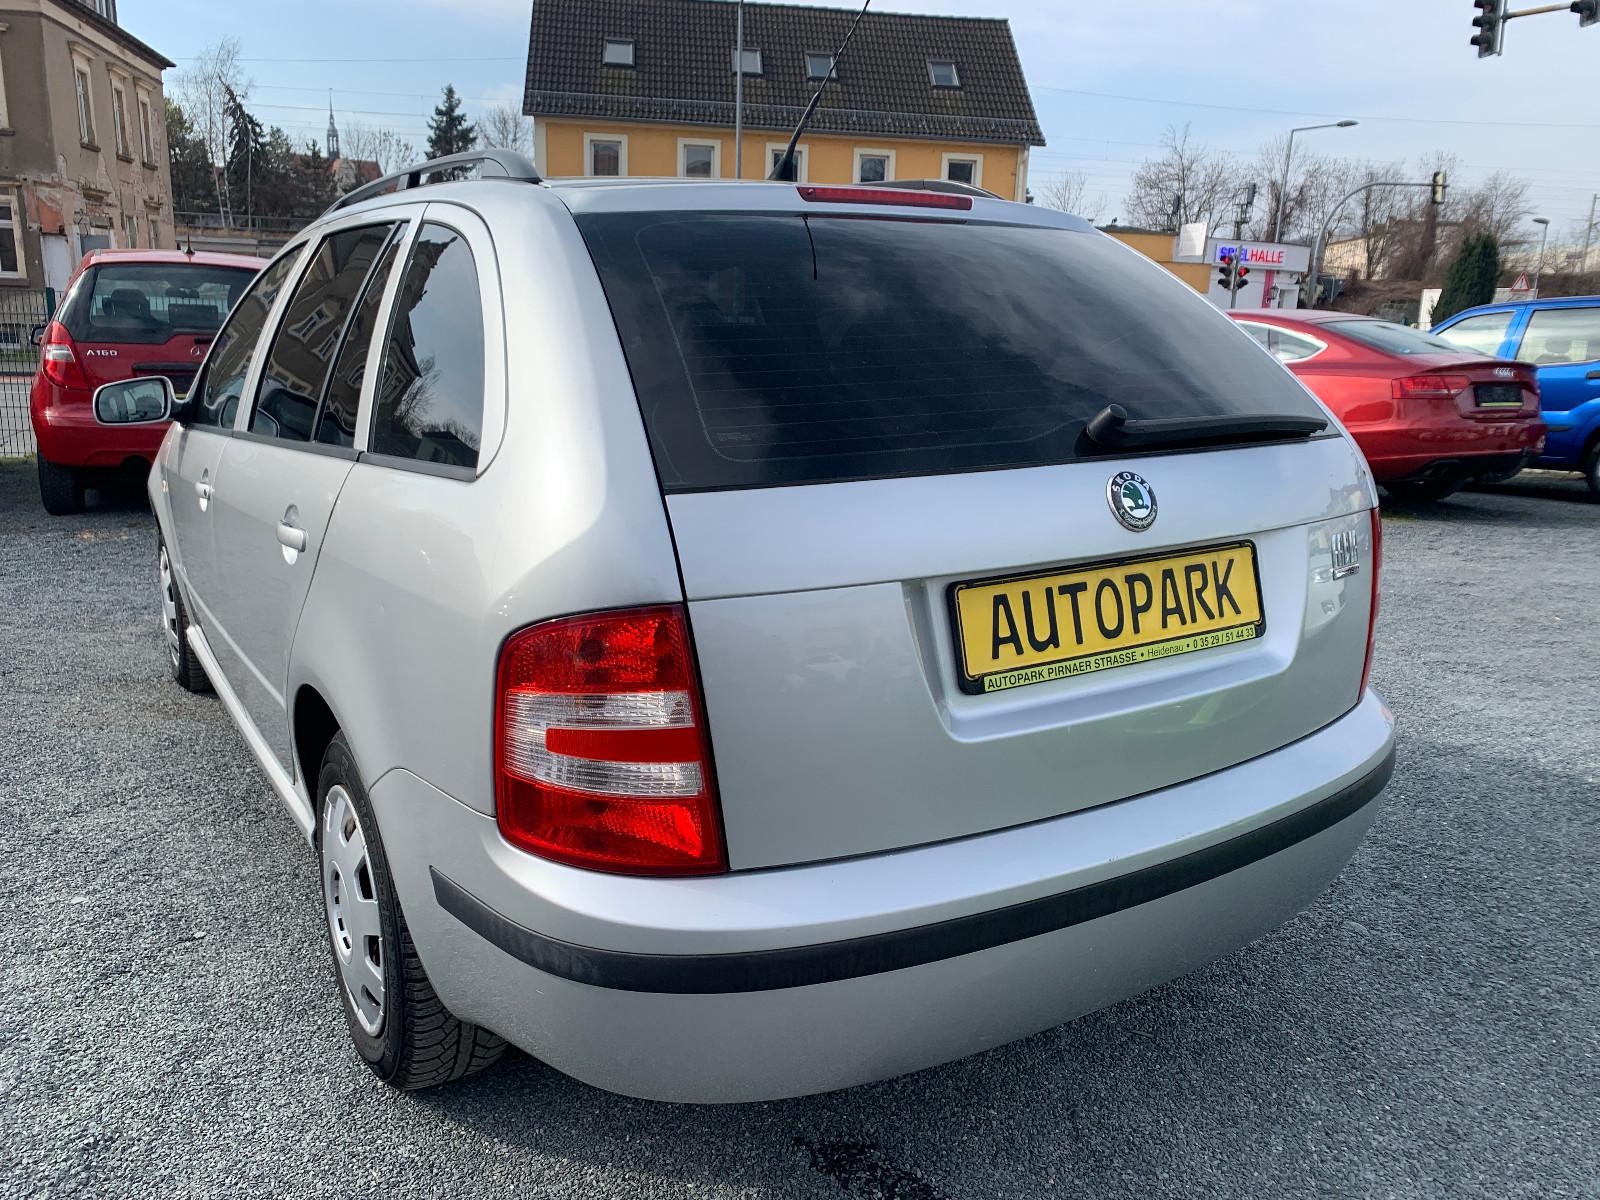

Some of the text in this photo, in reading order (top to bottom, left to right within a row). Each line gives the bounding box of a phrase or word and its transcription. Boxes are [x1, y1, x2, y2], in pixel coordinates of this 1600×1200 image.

[991, 558, 1241, 659] AUTOPARK
[987, 668, 1045, 690] AUTOPARK
[1047, 660, 1092, 678] PIRNAER
[1094, 651, 1137, 669] STRASSE
[1147, 644, 1184, 658] Heidenau
[1200, 637, 1209, 647] 35
[1211, 635, 1220, 645] 29
[1225, 632, 1234, 641] 51
[1236, 629, 1244, 638] 44
[1246, 627, 1254, 637] 33
